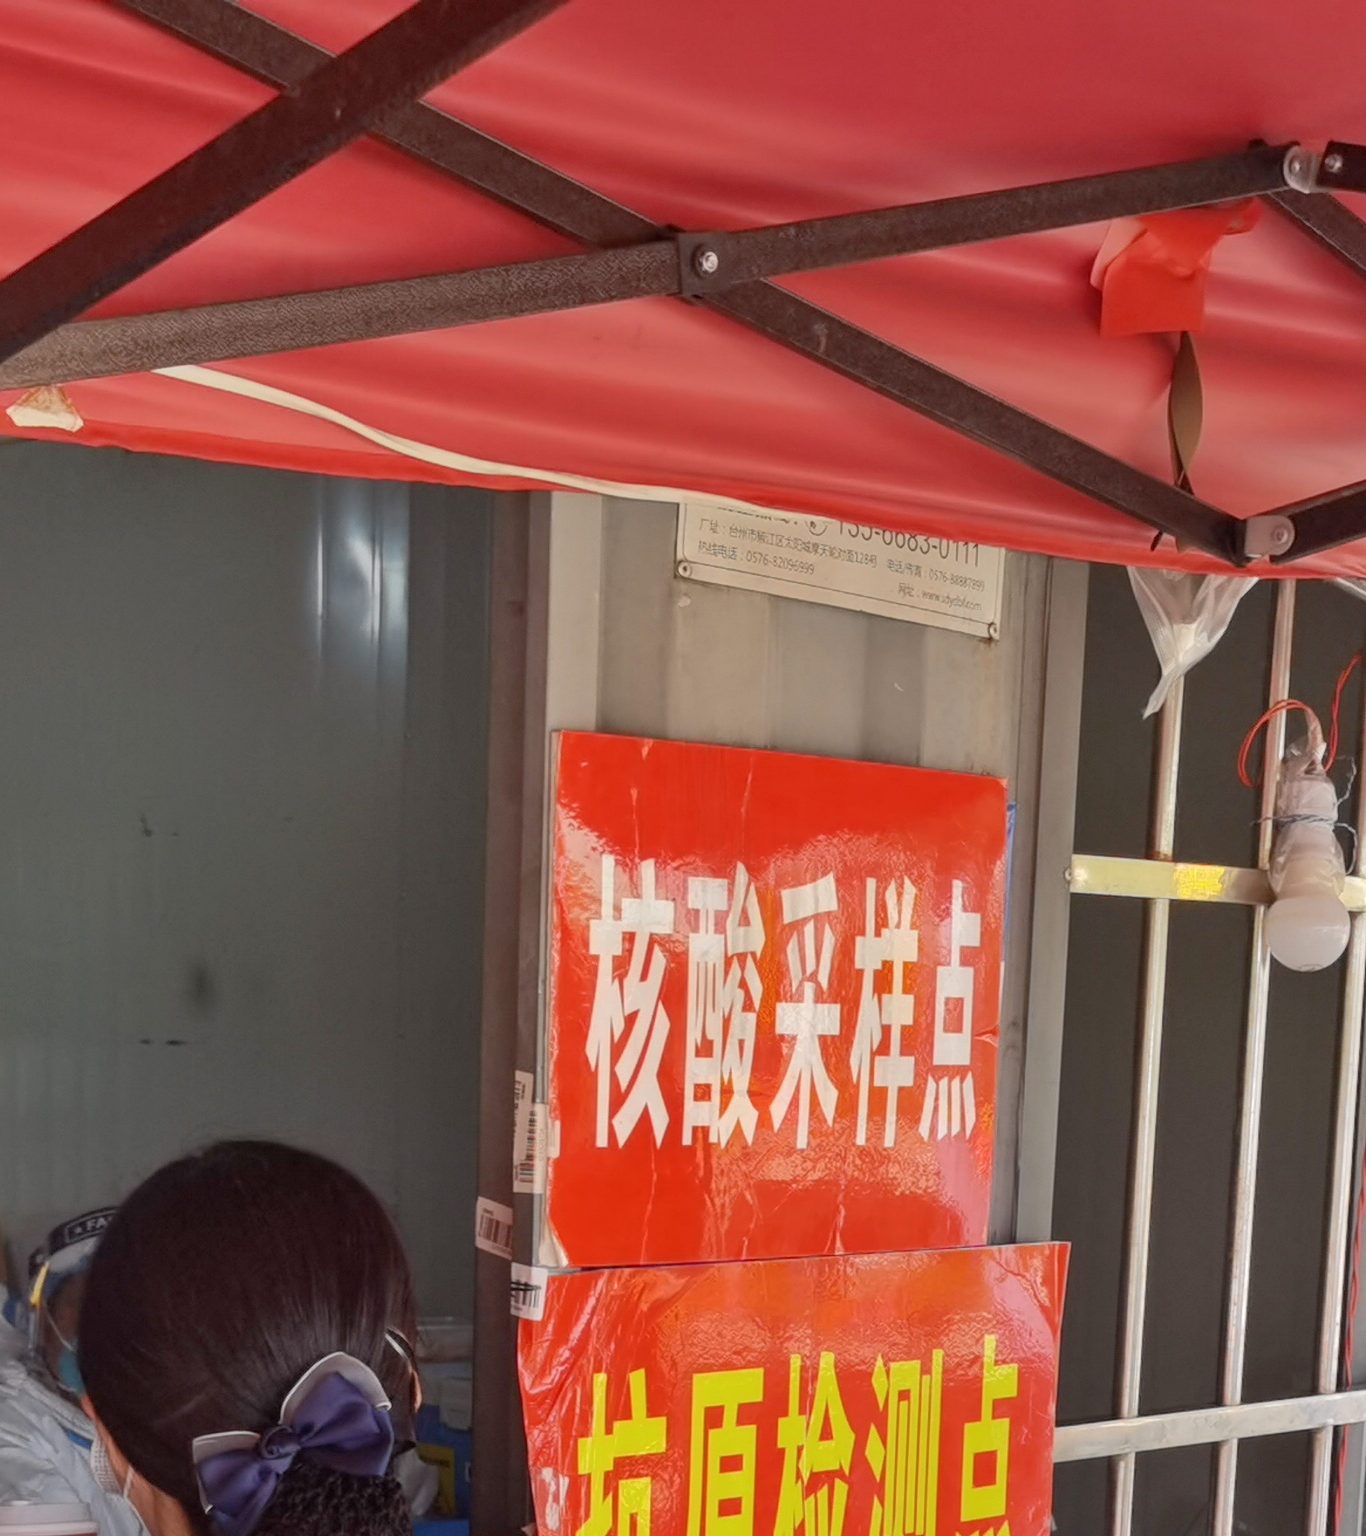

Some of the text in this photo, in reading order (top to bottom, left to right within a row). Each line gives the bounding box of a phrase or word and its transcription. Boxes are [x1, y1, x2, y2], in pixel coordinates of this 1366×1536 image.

[585, 854, 981, 1149] 核酸采样点
